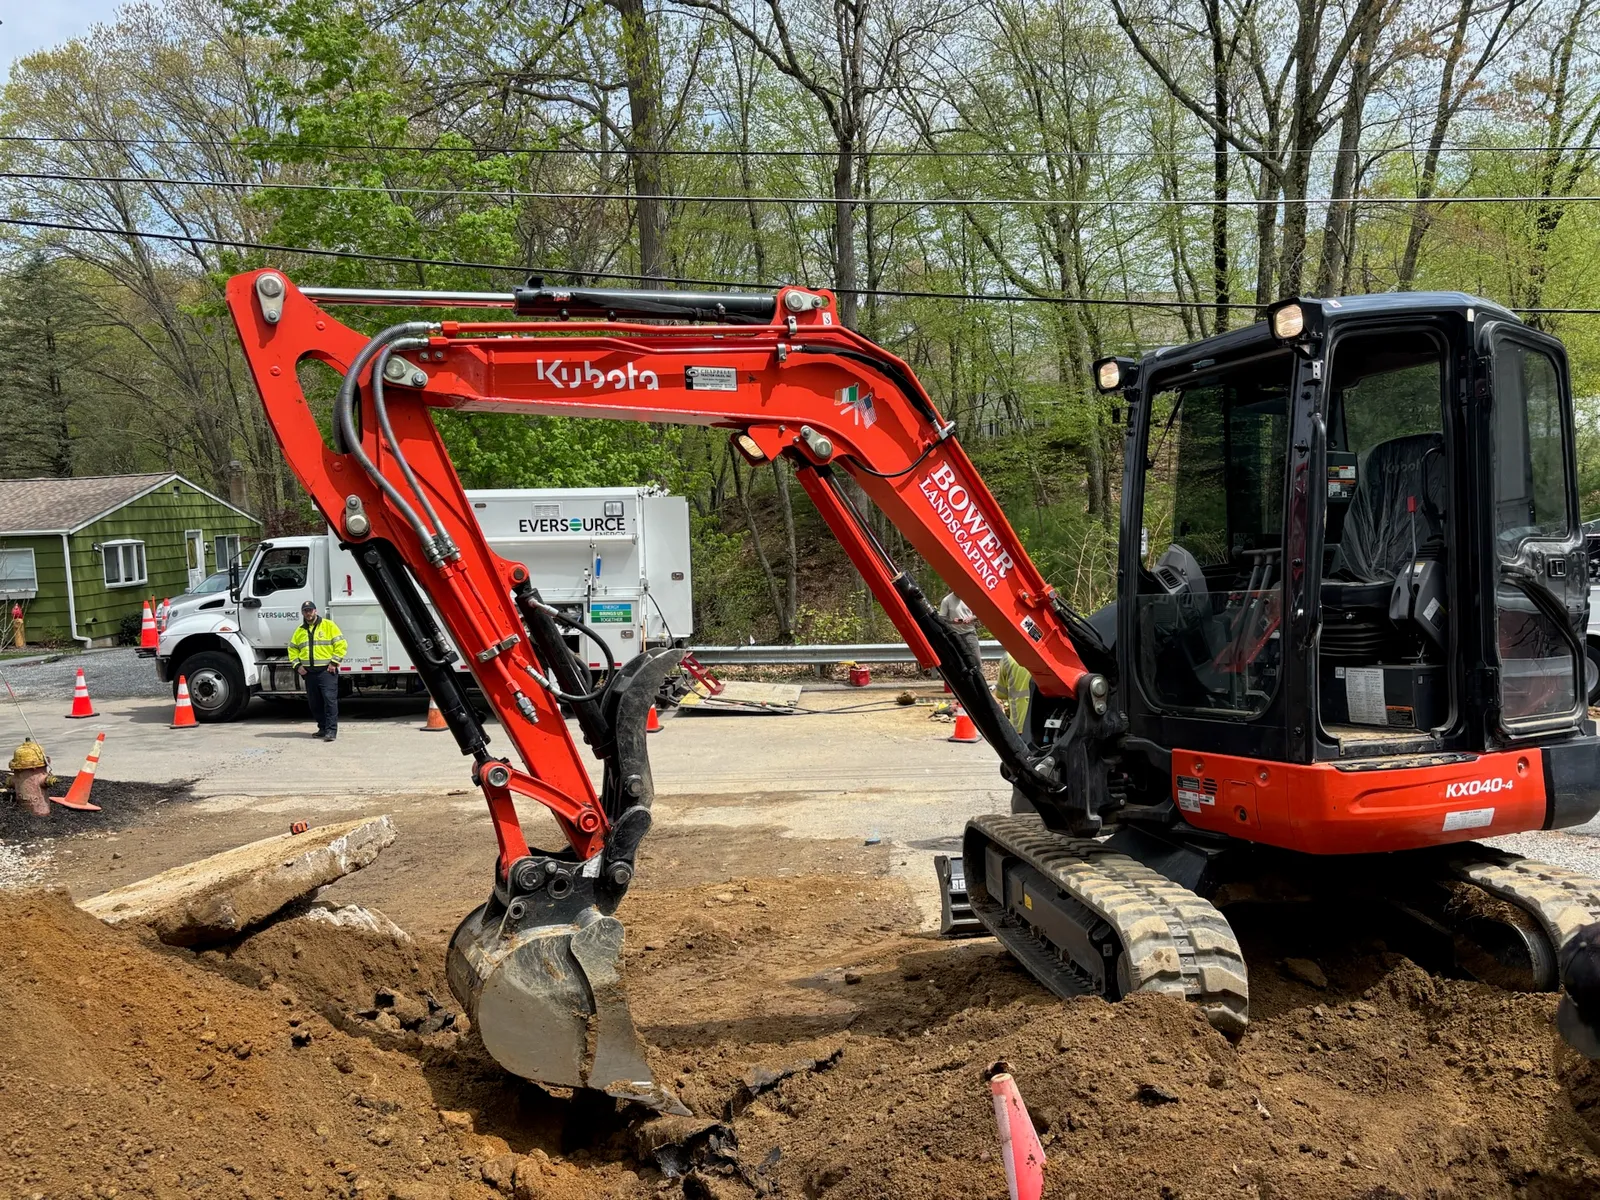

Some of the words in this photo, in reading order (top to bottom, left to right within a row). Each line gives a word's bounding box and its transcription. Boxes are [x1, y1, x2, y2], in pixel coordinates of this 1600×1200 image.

[536, 359, 659, 390] Kubota
[519, 518, 626, 532] EVERSOURCE
[931, 460, 1015, 579] BOWER
[918, 476, 999, 592] LANDSCAPING
[257, 611, 300, 619] EVERSOURCE
[1445, 777, 1513, 799] KX040-4
